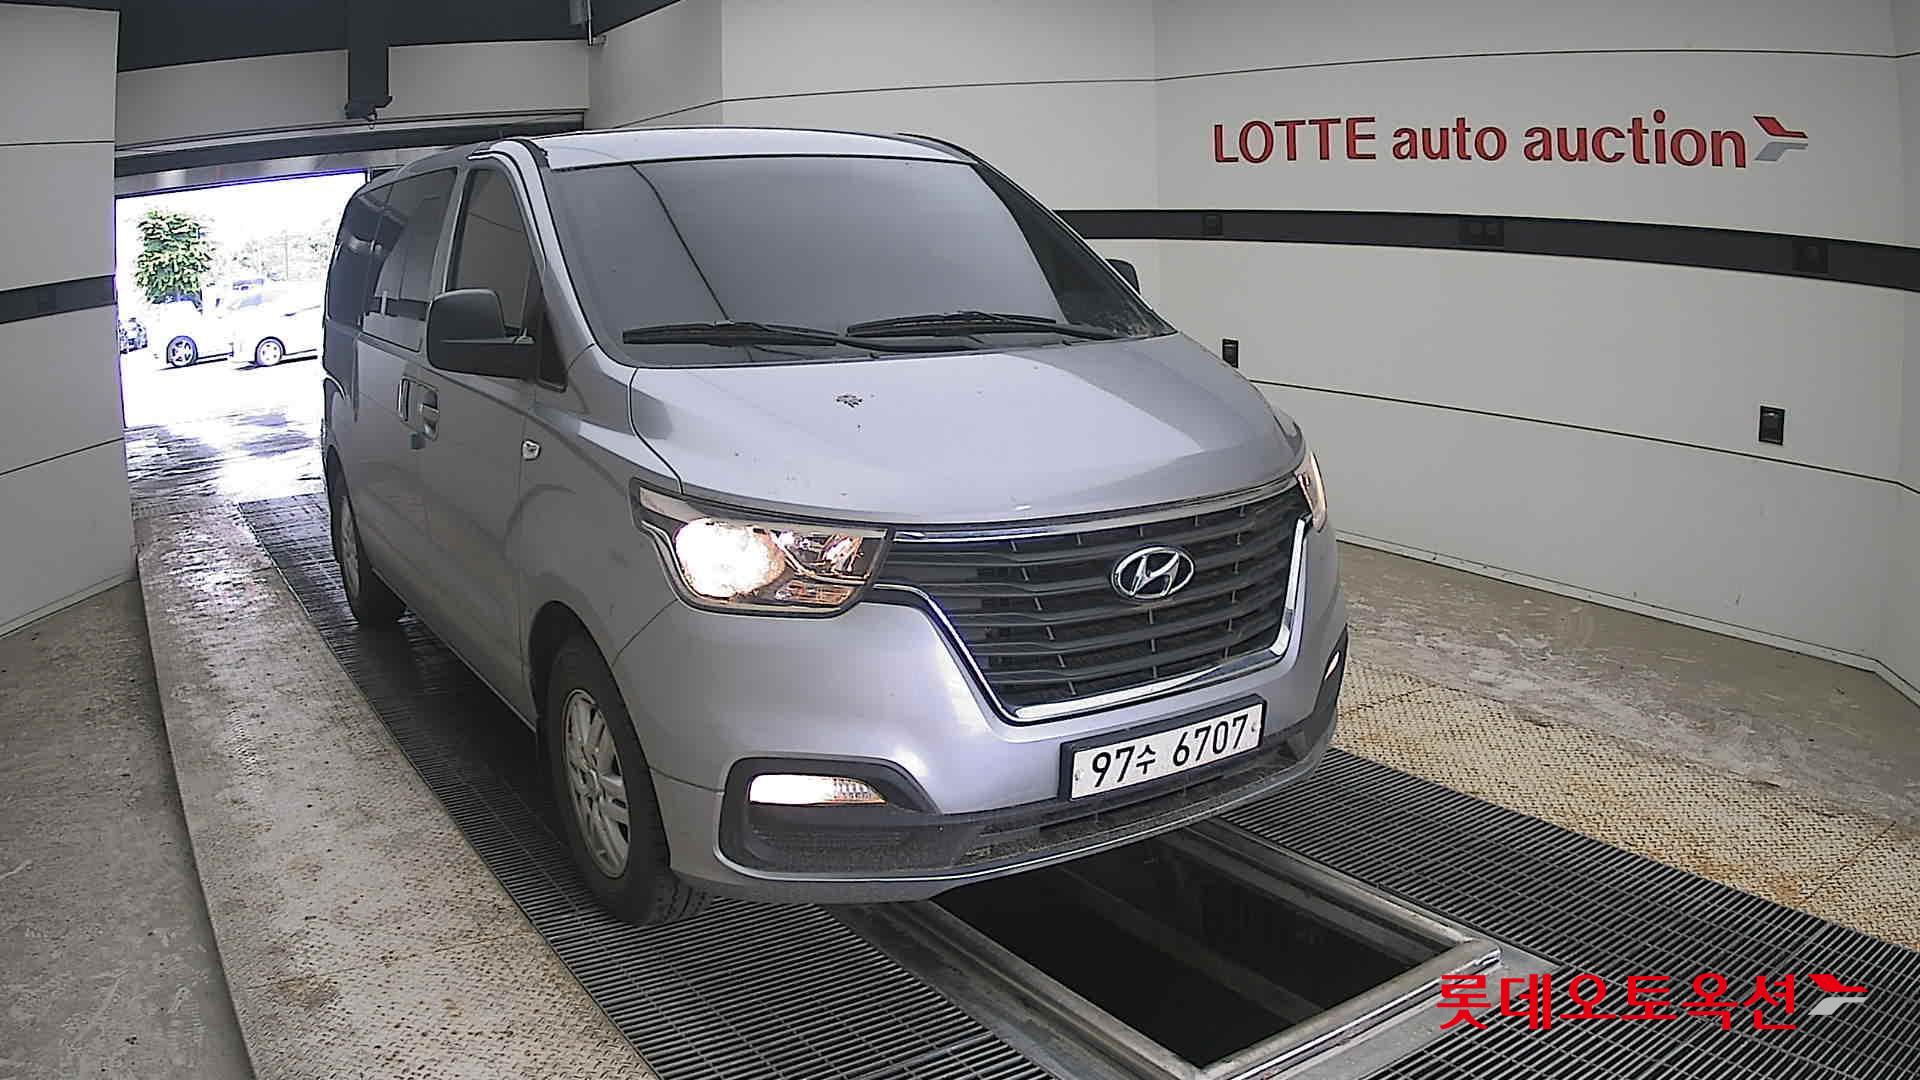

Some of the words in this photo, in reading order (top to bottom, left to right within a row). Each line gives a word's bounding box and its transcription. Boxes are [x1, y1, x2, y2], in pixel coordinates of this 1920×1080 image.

[1213, 116, 1377, 163] LOTTE
[1392, 116, 1507, 162] auto
[1522, 109, 1747, 169] auction
[1092, 744, 1156, 788] 97수
[1172, 714, 1249, 767] 6707
